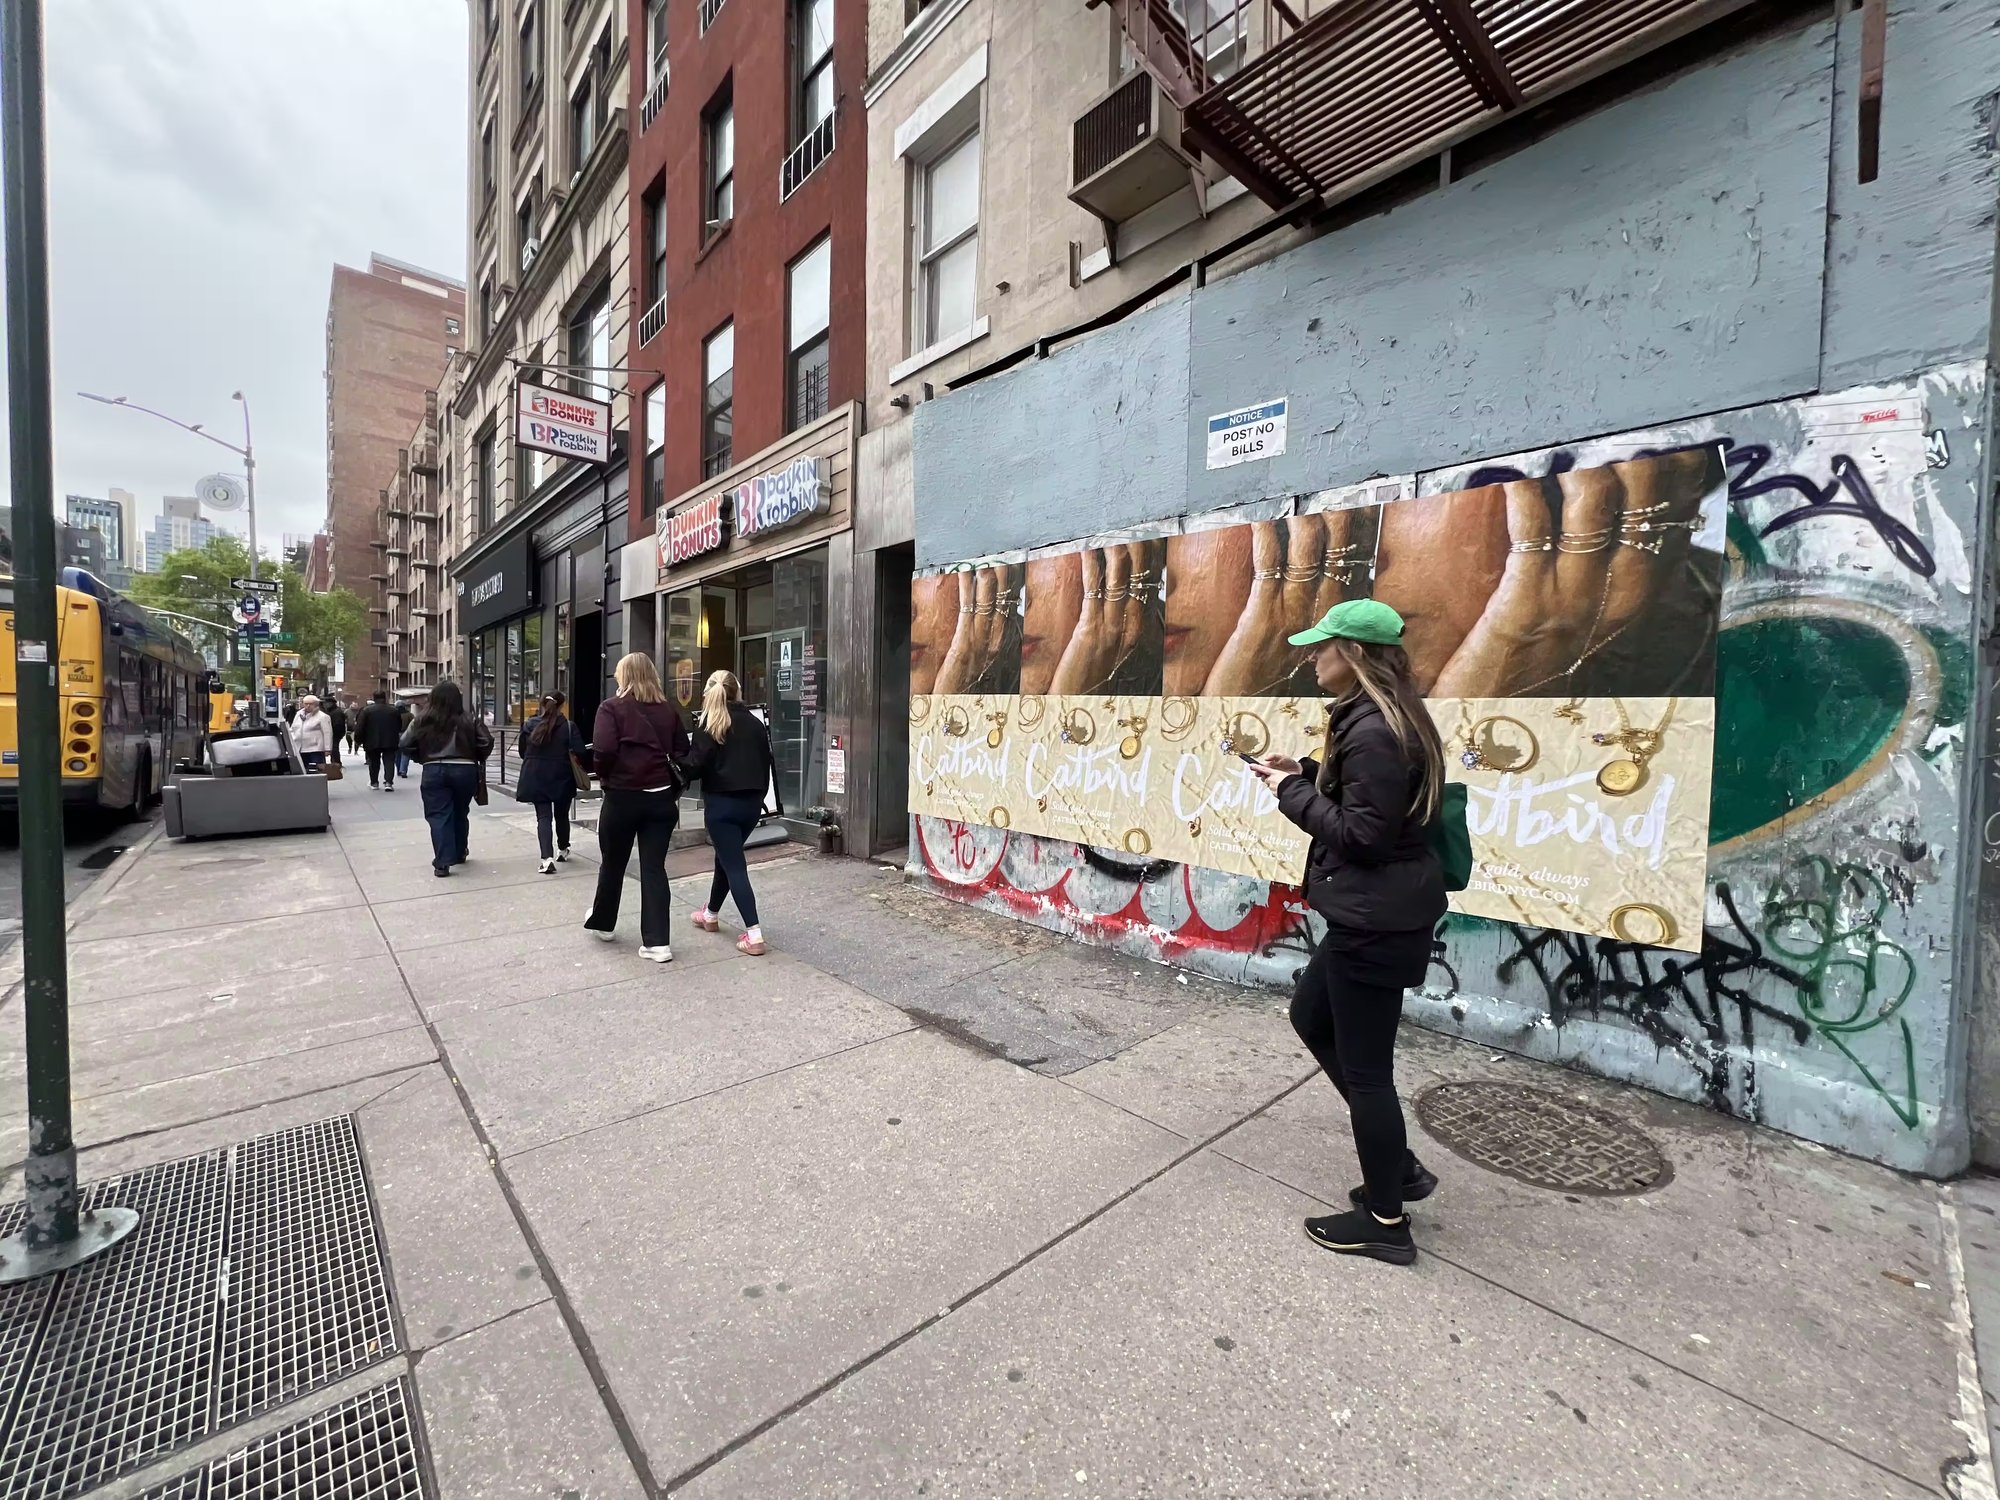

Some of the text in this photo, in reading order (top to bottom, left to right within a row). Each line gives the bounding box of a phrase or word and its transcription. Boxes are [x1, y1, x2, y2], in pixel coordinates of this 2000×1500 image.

[549, 399, 597, 418] DUNKIN'
[549, 408, 595, 427] DONUTS
[1229, 409, 1263, 426] NOTICE
[530, 422, 559, 445] BR
[559, 429, 598, 447] baskin
[1223, 422, 1275, 444] POST NO
[559, 439, 597, 455] robbins
[1231, 440, 1264, 457] BILLS
[766, 456, 817, 497] baskin
[672, 495, 721, 539] DUNKIN'
[734, 477, 766, 538] BR
[767, 485, 818, 524] robbins
[673, 522, 718, 562] DONUTS
[782, 644, 790, 661] A
[916, 735, 1011, 789] Catbird
[1025, 741, 1152, 807] Catbird
[1172, 752, 1281, 821] Catb
[1207, 824, 1233, 838] Solid
[1262, 832, 1300, 851] always
[1483, 861, 1524, 880] gold,
[1528, 866, 1591, 890] always
[1467, 879, 1580, 905] TBIRDNYC.COM
